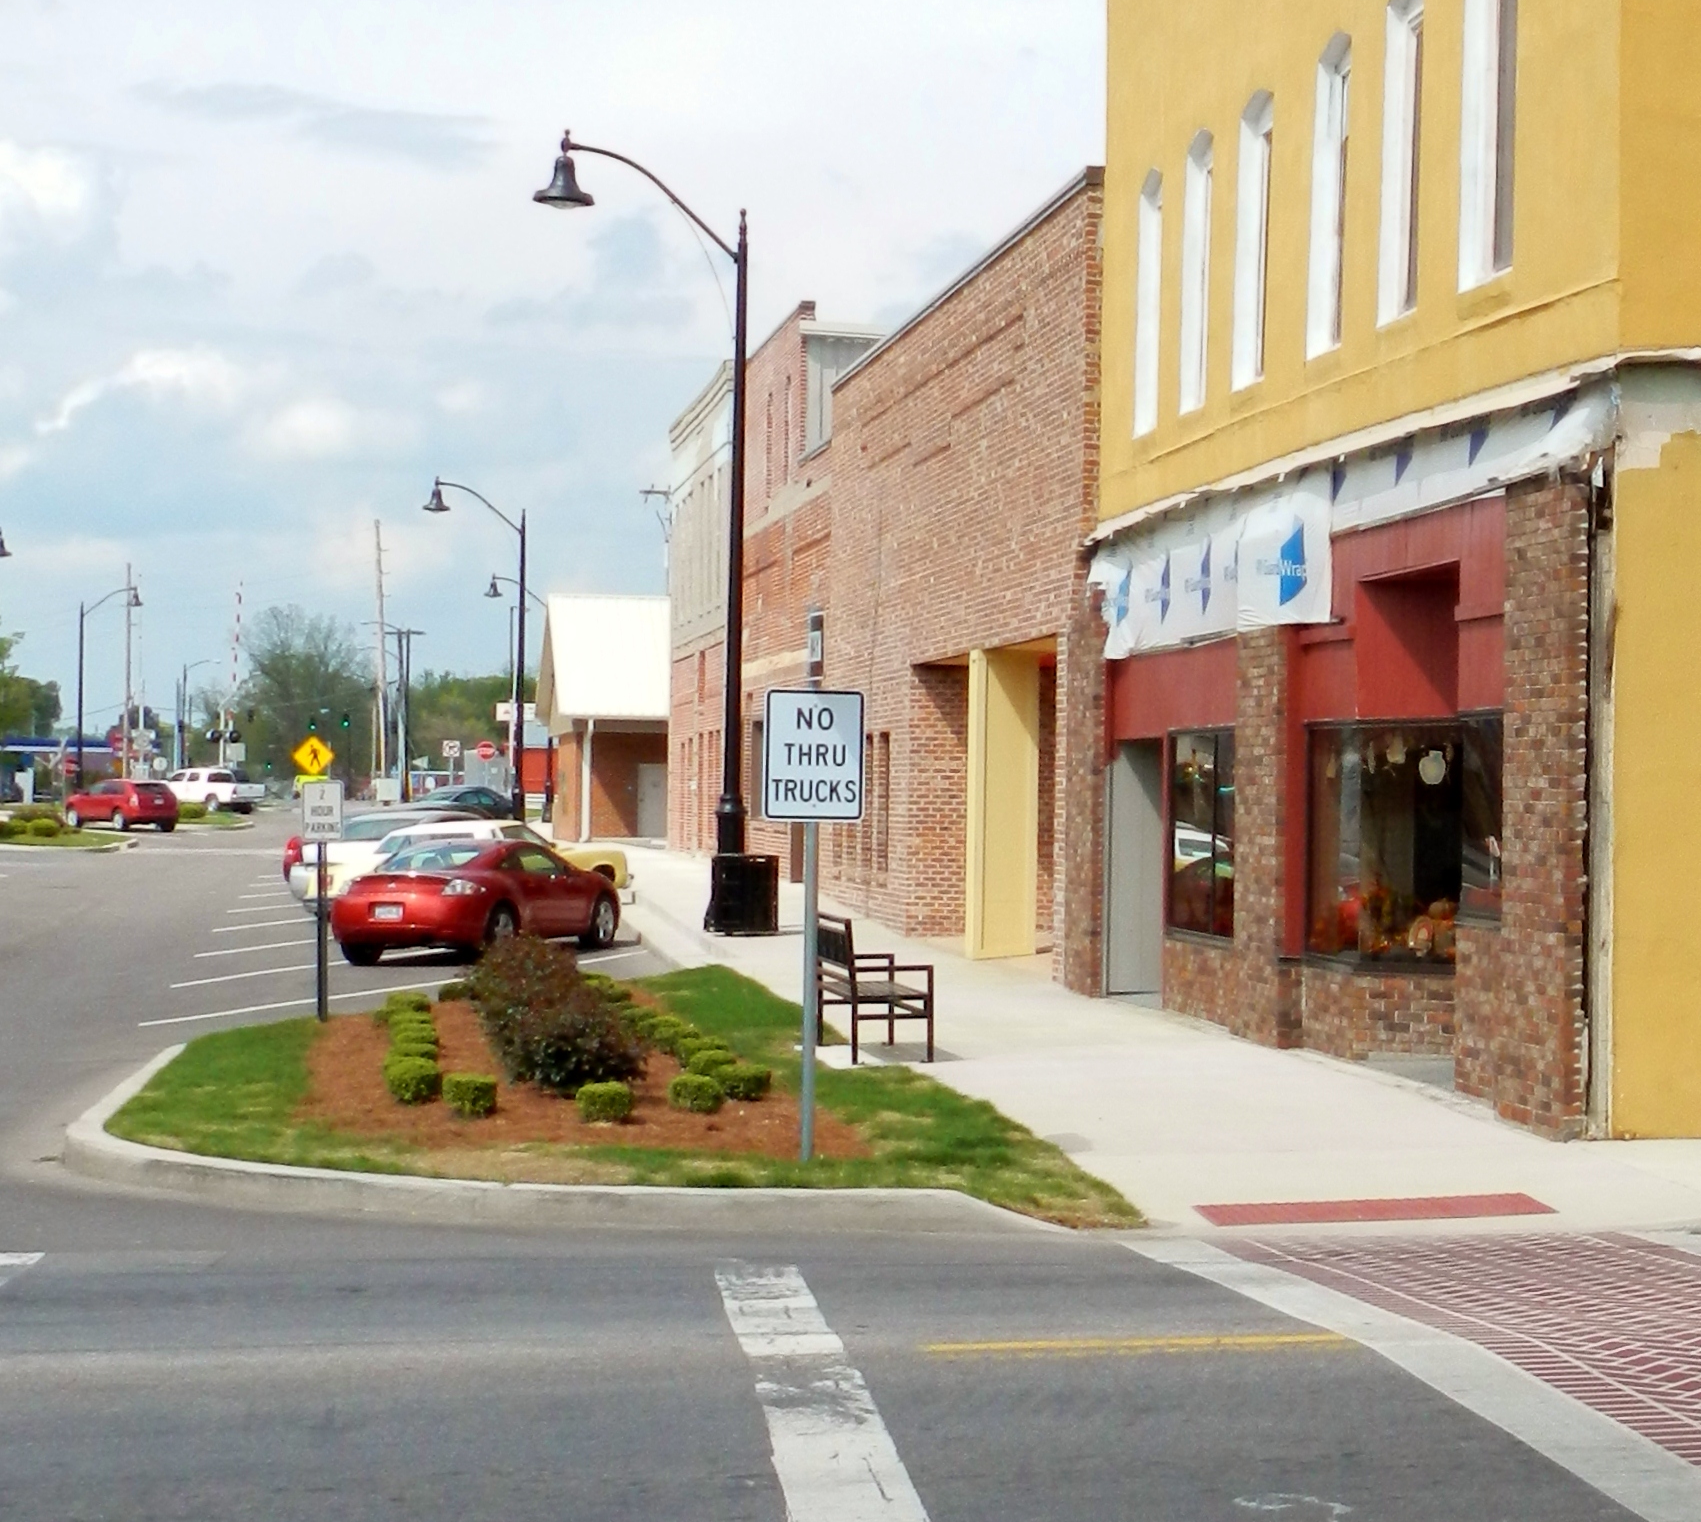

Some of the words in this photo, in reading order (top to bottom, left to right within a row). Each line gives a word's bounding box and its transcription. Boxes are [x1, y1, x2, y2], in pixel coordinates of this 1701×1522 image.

[796, 707, 834, 731] NO
[784, 743, 846, 767] THRU
[771, 779, 857, 803] TRUCKS
